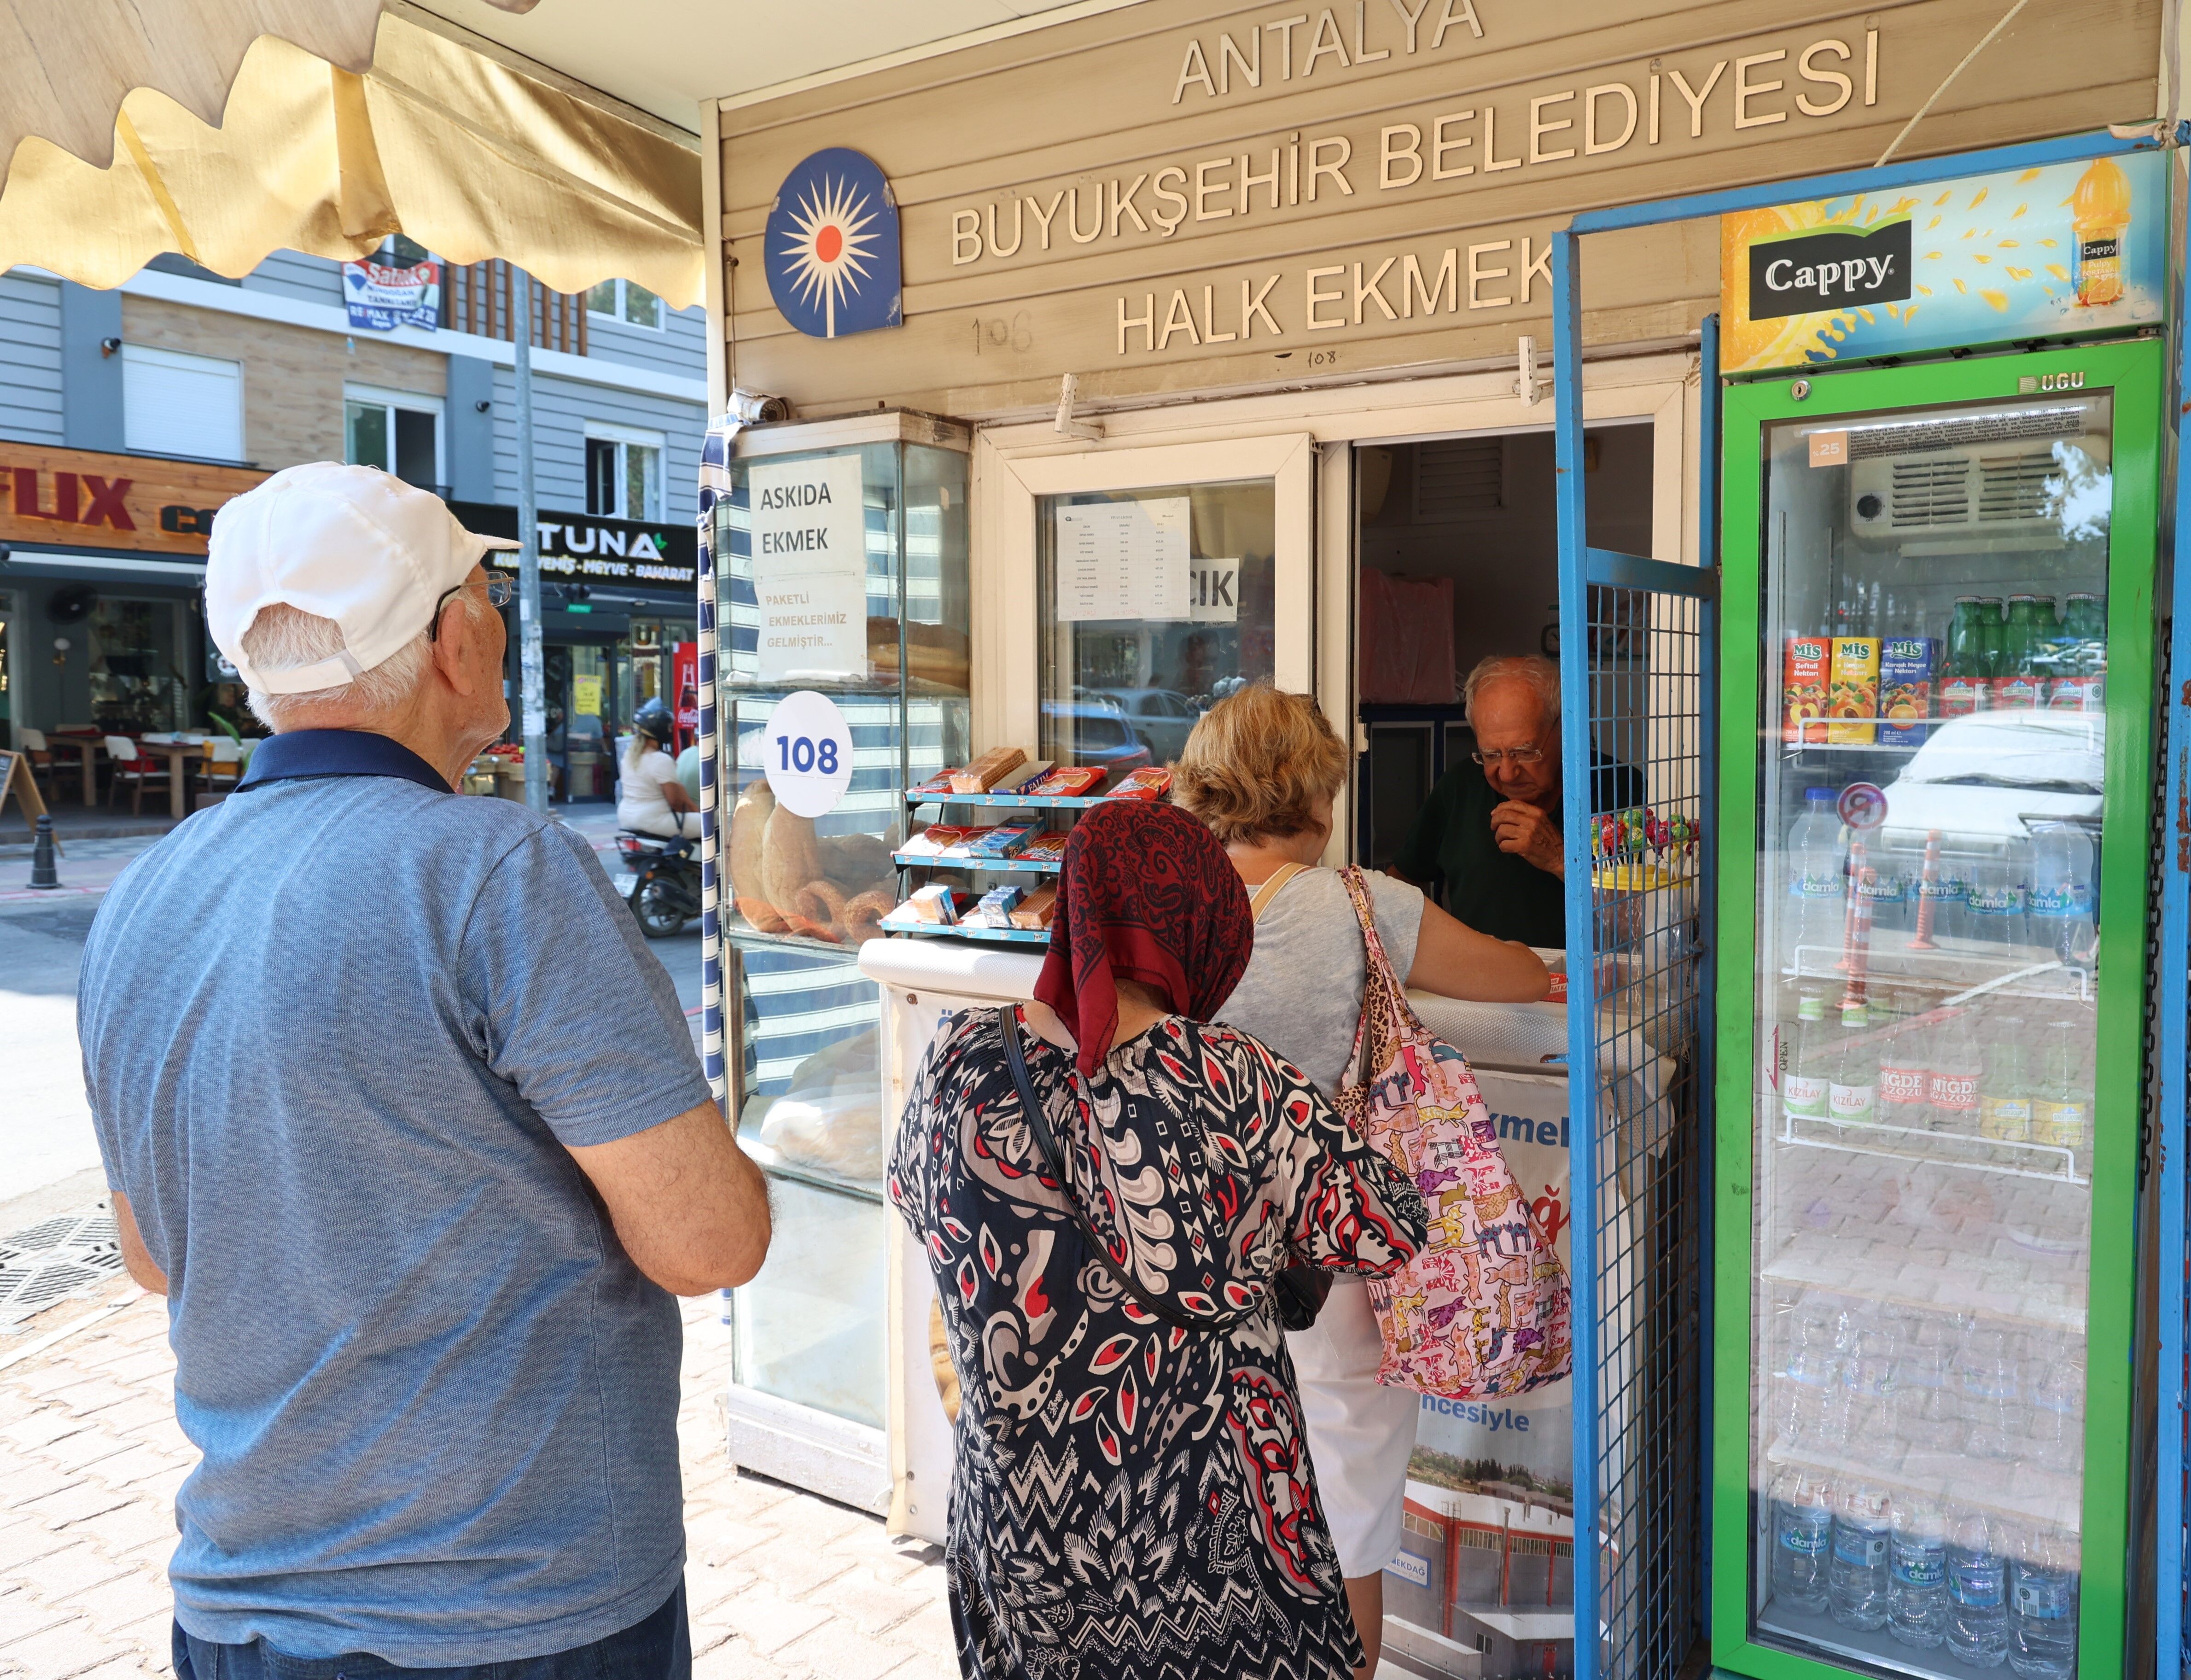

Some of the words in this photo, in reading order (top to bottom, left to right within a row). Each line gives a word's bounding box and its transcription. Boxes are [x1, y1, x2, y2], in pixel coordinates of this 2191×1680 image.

[1171, 0, 1484, 104] ANTALYA
[2084, 245, 2117, 256] Cappy
[1766, 254, 1894, 296] Cappy
[1117, 274, 1282, 355] HALK
[1306, 237, 1553, 331] EKMEK
[1307, 350, 1336, 368] 108
[760, 482, 832, 510] ASKIDA
[536, 521, 664, 561] TUNA
[762, 527, 828, 554] EKMEK
[583, 560, 629, 577] MEYVE
[635, 566, 695, 582] BAHARAT
[766, 591, 810, 606] PAKETLİ
[769, 611, 846, 627] EKMEKLERİMİZ
[776, 735, 838, 775] 108
[1802, 881, 1839, 892] damla
[1858, 884, 1897, 896] damla
[1969, 896, 2008, 909] damla
[1779, 1041, 1788, 1071] OPEN
[1788, 1086, 1821, 1098] KIZILAY
[1880, 1085, 1922, 1097] AZOZU
[1833, 1094, 1865, 1107] KIZILAY
[1790, 1536, 1826, 1548] damla
[1397, 1558, 1425, 1576] EKDAĞ
[1909, 1568, 1944, 1581] damla
